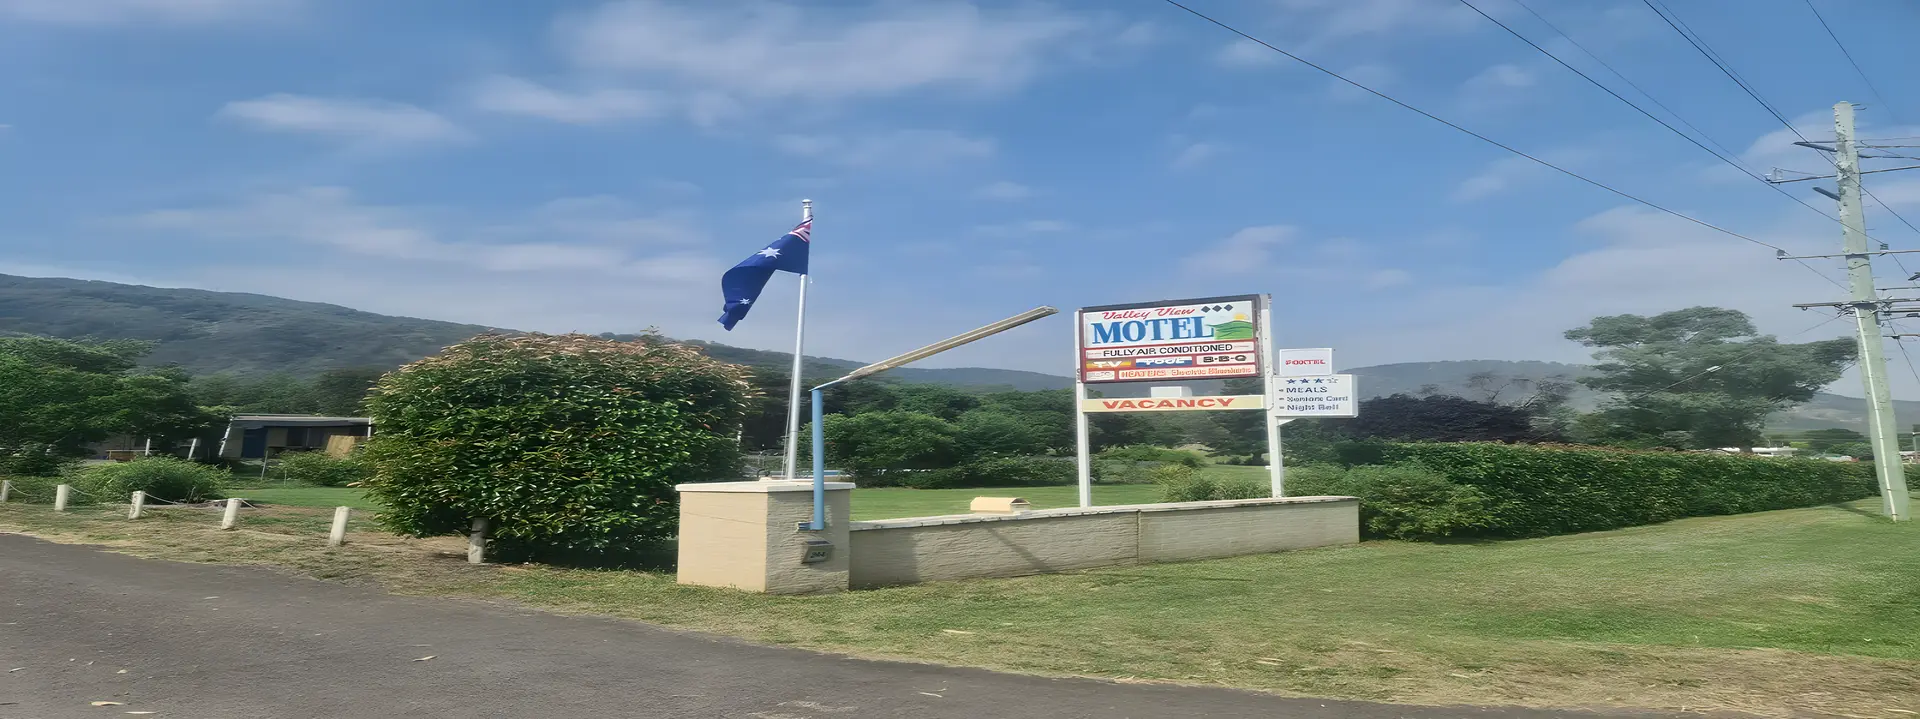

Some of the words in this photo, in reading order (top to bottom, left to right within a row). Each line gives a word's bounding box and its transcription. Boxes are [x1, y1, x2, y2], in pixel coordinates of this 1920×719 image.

[1102, 309, 1151, 320] Valley
[1155, 307, 1195, 317] View
[1091, 316, 1215, 345] MOTEL
[1103, 348, 1136, 357] FULLY
[1159, 344, 1233, 355] CONDITIONED
[1102, 397, 1235, 410] VACANCY
[1287, 404, 1315, 412] Night
